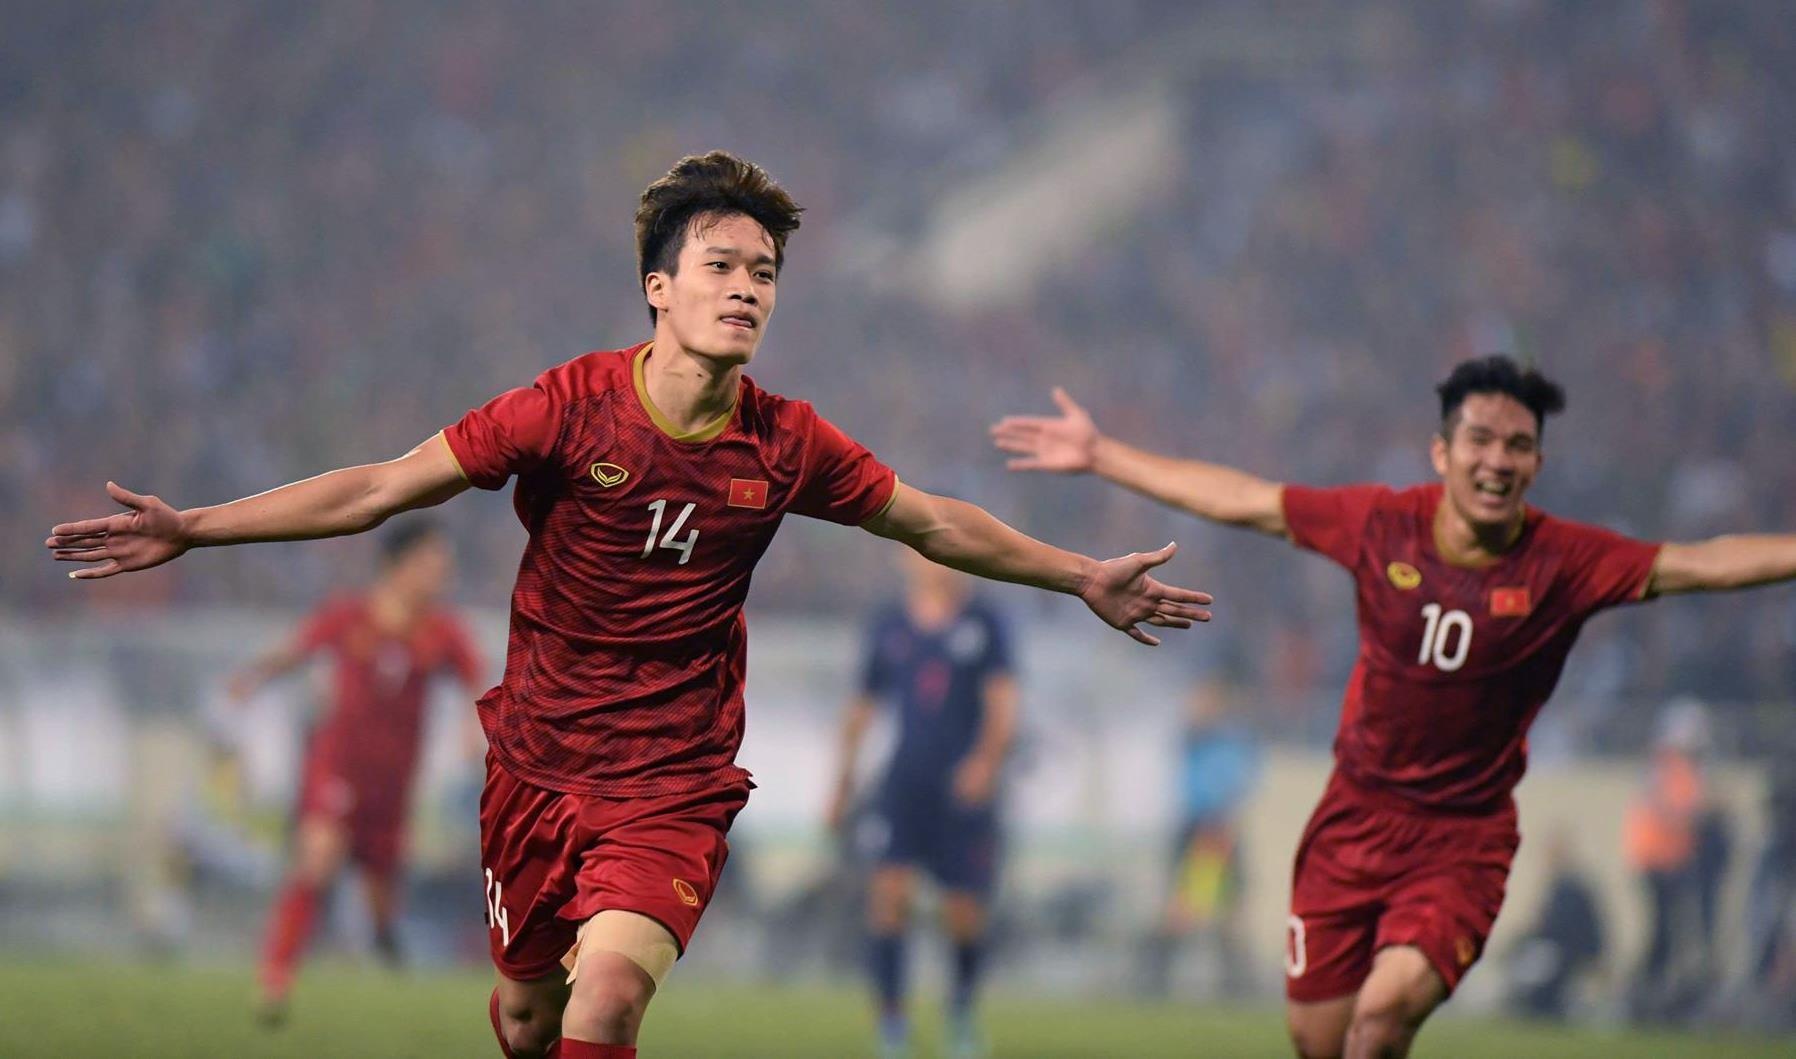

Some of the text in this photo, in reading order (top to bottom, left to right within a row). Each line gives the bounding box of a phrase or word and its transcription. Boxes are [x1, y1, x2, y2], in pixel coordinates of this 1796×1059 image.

[640, 499, 699, 565] 14
[1417, 602, 1473, 671] 10
[485, 867, 509, 947] 14
[1286, 914, 1307, 978] 0
